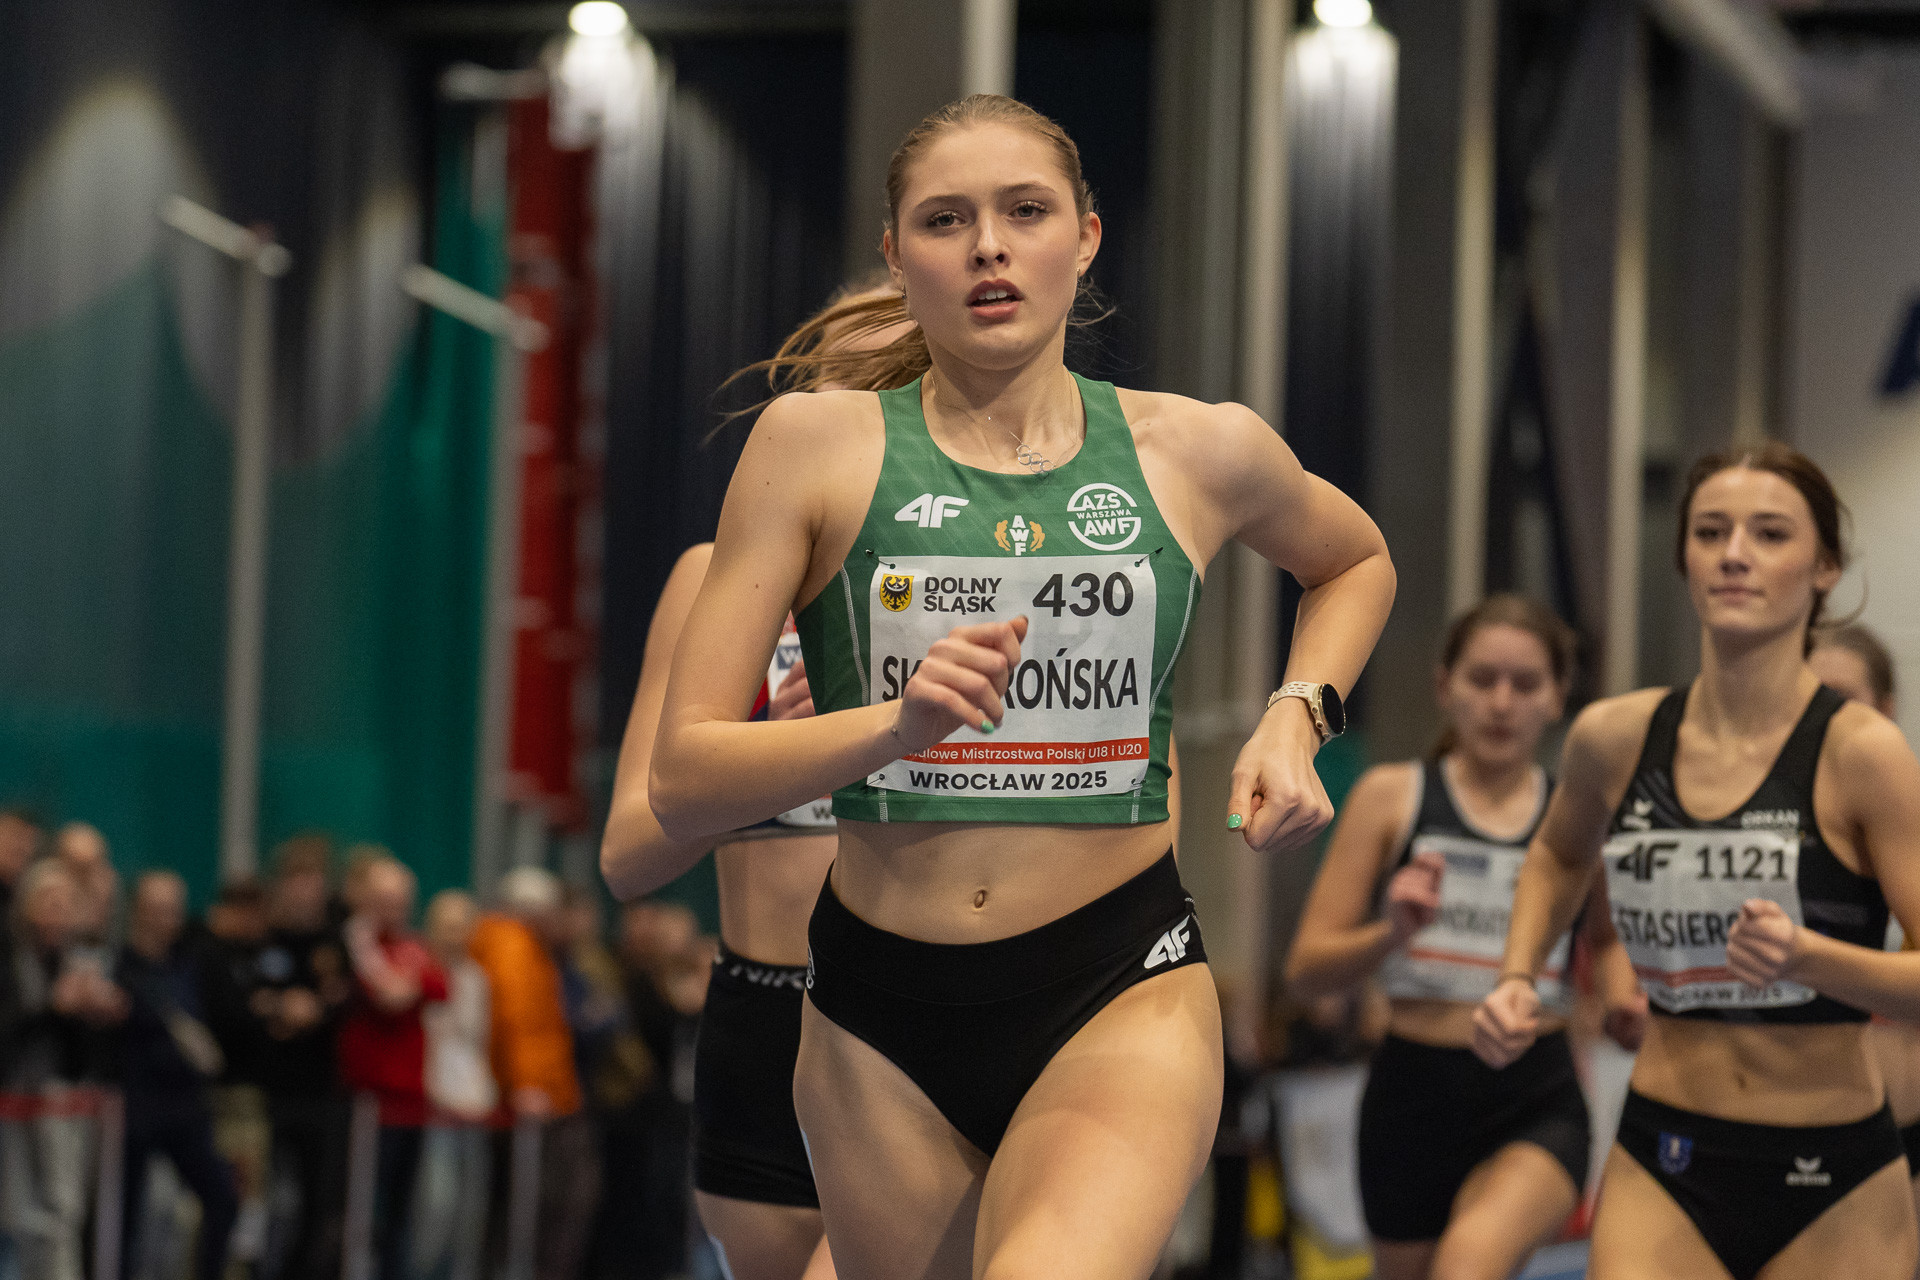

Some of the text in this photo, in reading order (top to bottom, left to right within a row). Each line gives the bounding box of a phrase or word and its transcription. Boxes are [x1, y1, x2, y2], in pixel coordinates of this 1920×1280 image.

[895, 493, 970, 528] 4F
[1082, 493, 1122, 511] AZS
[1076, 509, 1132, 519] WARSZAWA
[1083, 518, 1132, 536] AWF
[923, 592, 996, 615] ŚLĄSK
[925, 572, 1134, 617] DOLNY 430
[881, 648, 1139, 710] SKOŃSKA
[909, 743, 1142, 760] alowe Mistrzostwa Polski U18 i U20
[909, 770, 1108, 791] WROCŁAW 2025
[1696, 845, 1789, 881] 1121
[1144, 914, 1190, 969] 4F
